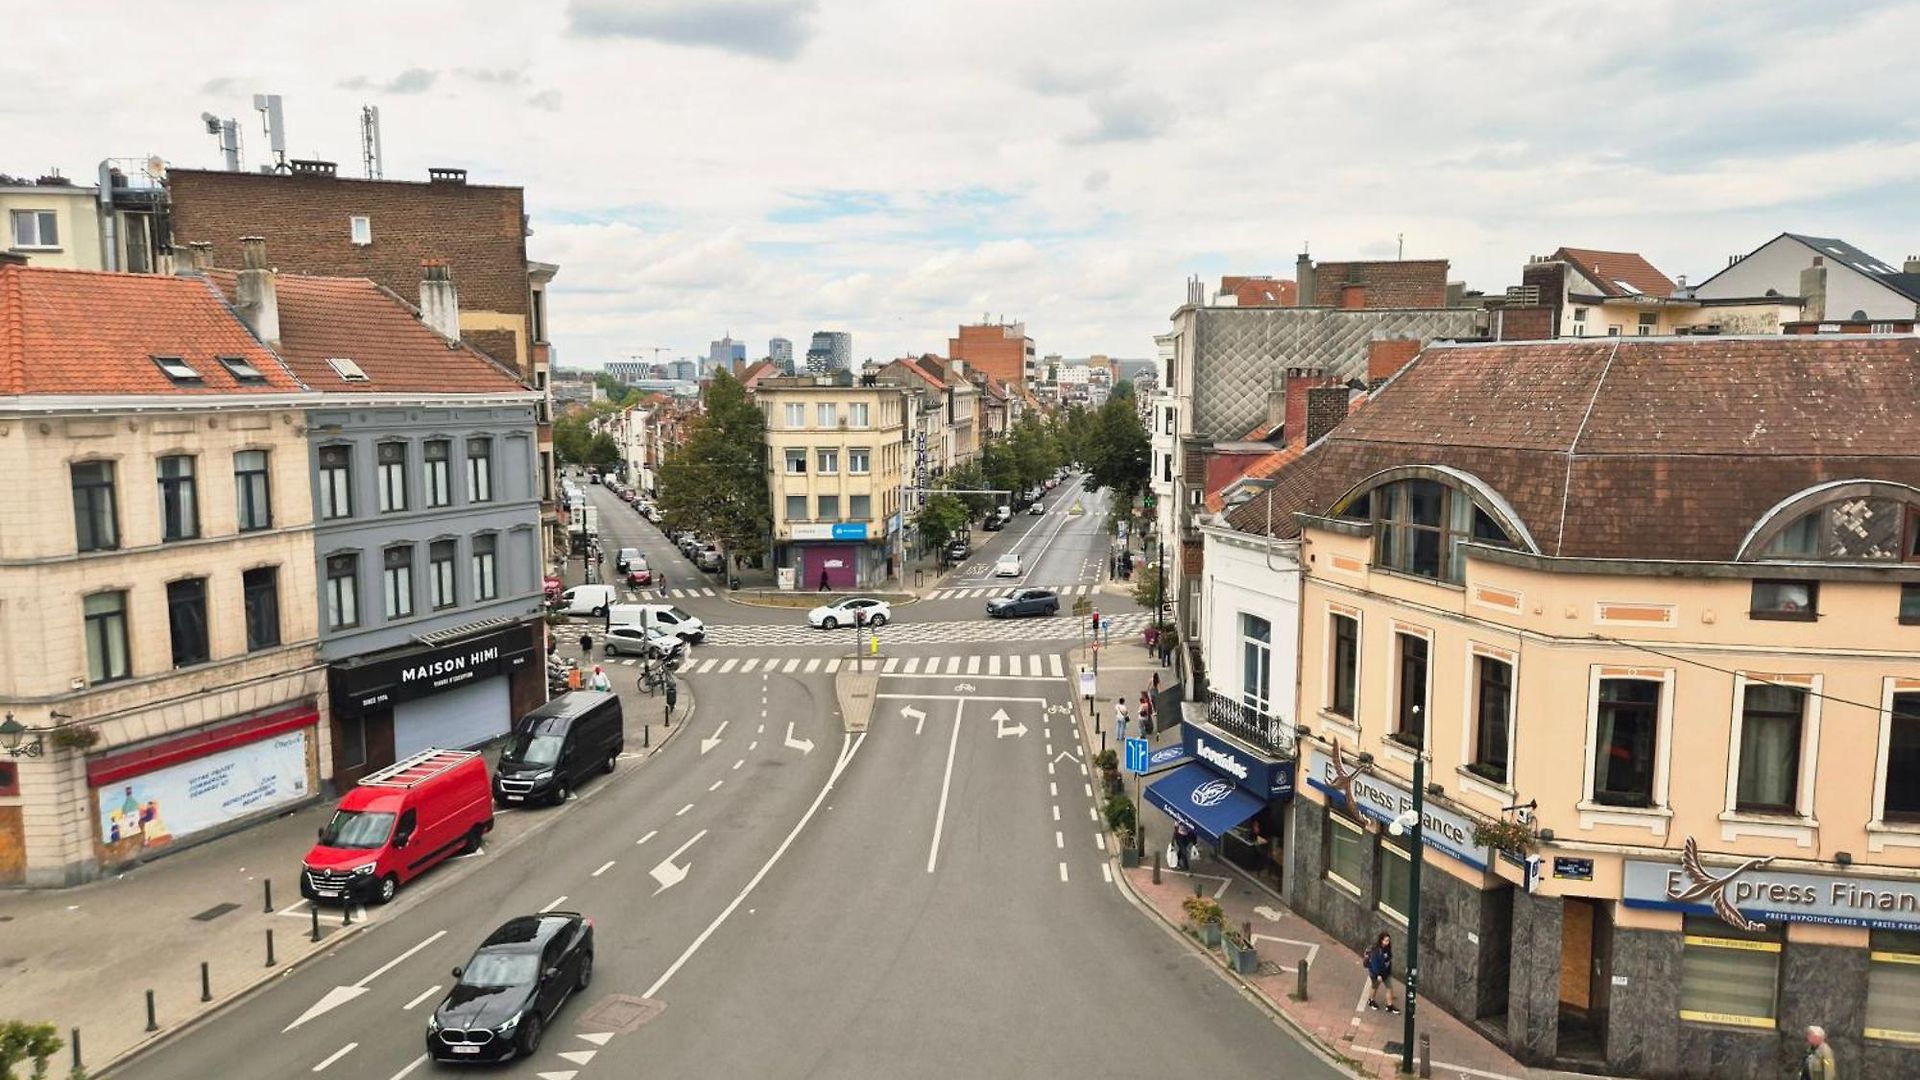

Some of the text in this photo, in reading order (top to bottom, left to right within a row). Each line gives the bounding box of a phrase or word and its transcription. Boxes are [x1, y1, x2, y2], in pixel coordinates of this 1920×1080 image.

[402, 647, 499, 682] MAISON HIMI
[1197, 738, 1248, 780] Leonidas
[1400, 797, 1465, 844] Fiance
[1830, 882, 1920, 912] Finan
